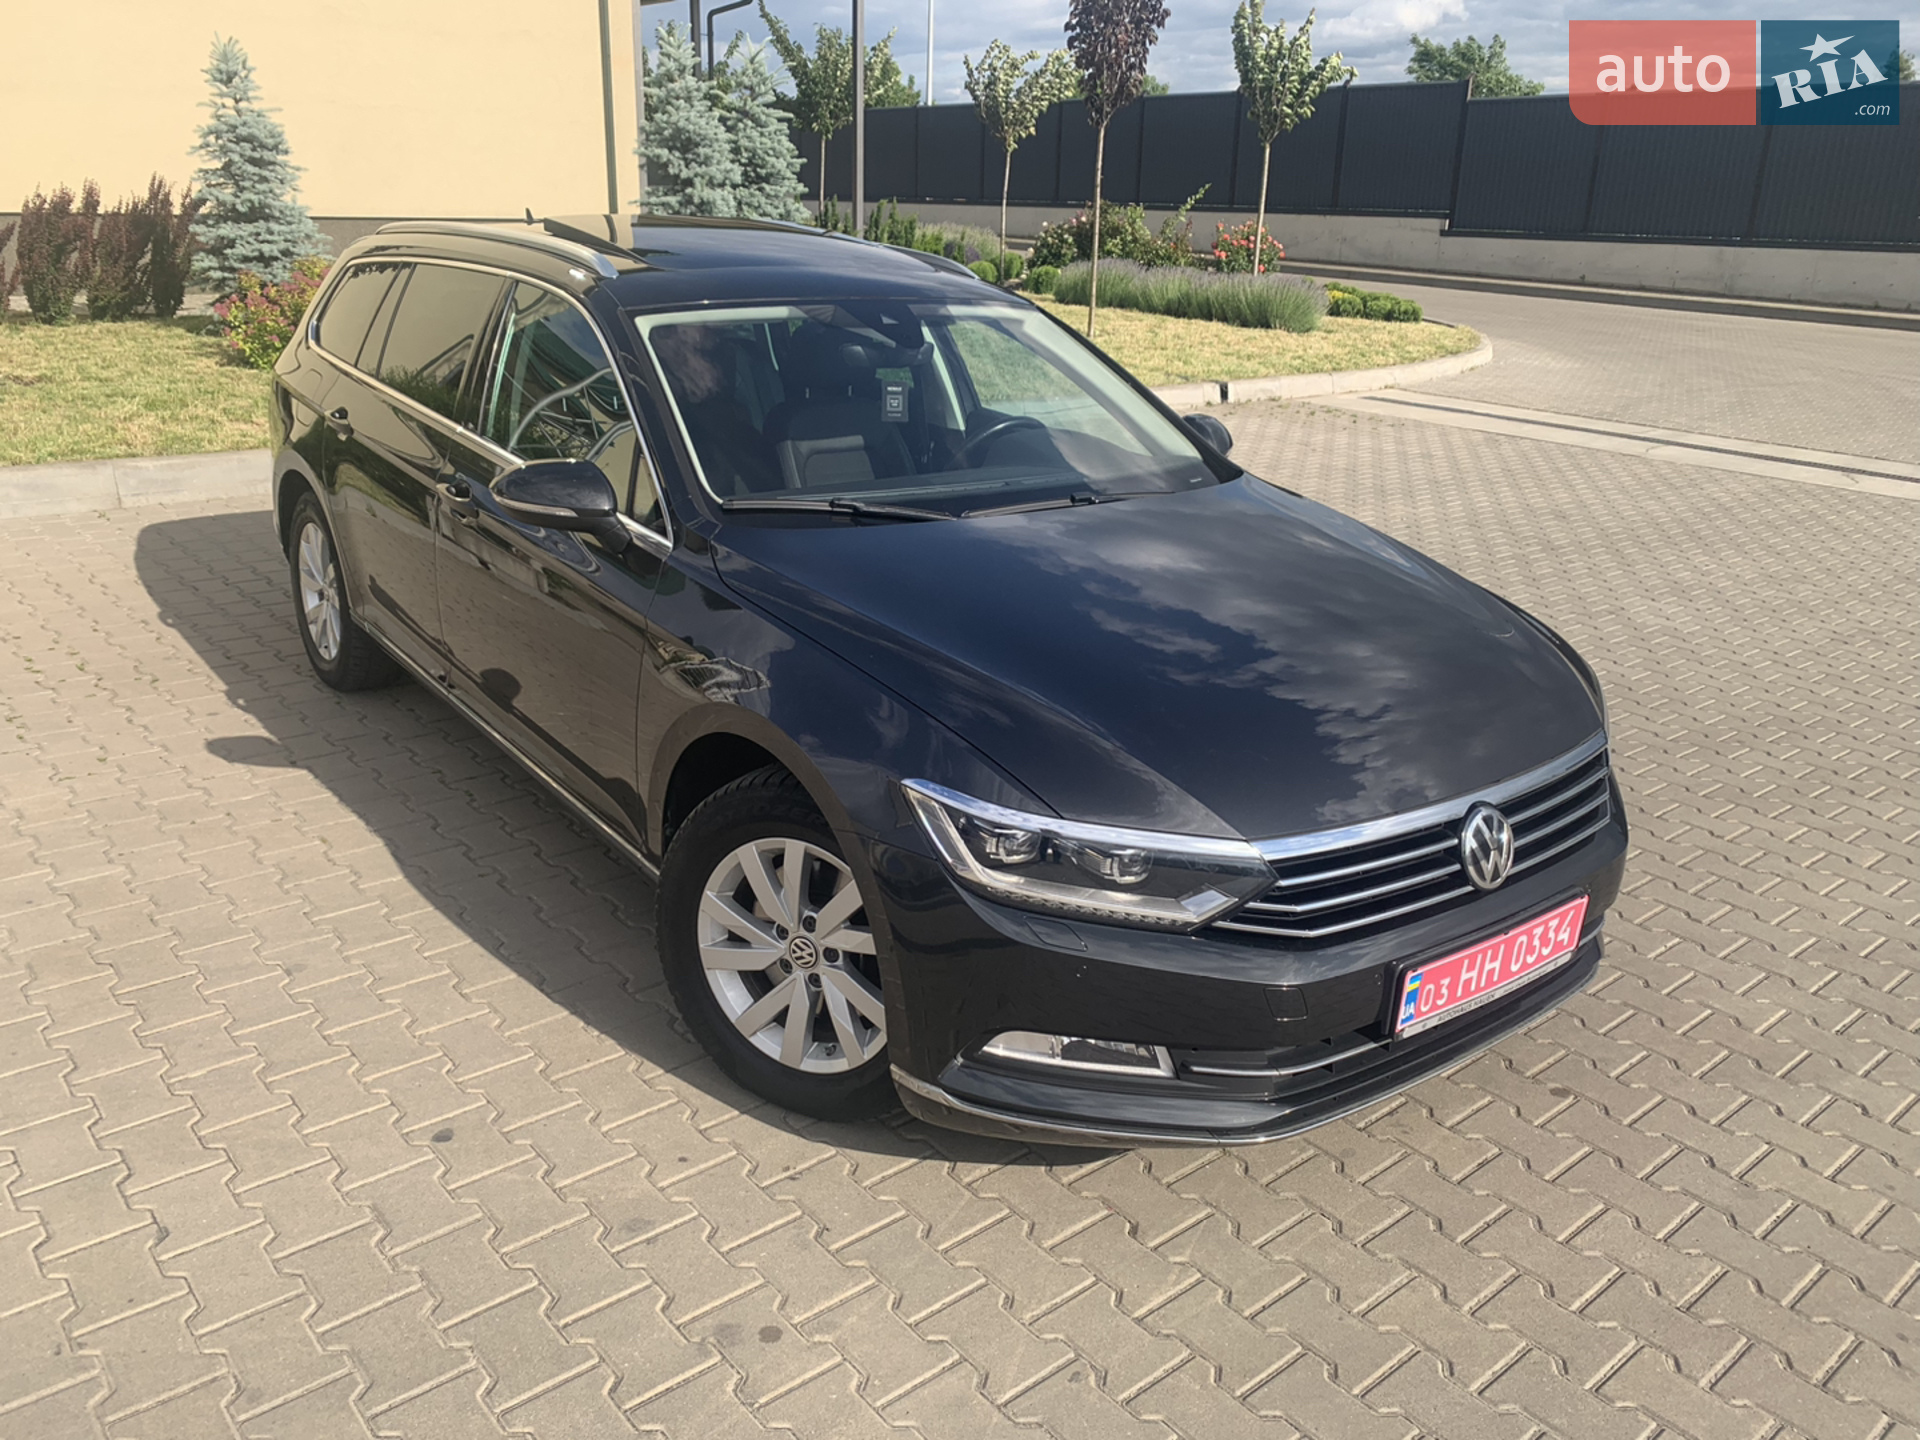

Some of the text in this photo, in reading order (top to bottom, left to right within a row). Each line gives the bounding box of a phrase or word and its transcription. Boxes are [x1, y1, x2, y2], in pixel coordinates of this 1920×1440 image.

[1419, 977, 1451, 1012] 03
[1456, 944, 1505, 997] HH
[1510, 909, 1576, 972] 0334
[1402, 1001, 1415, 1018] UA
